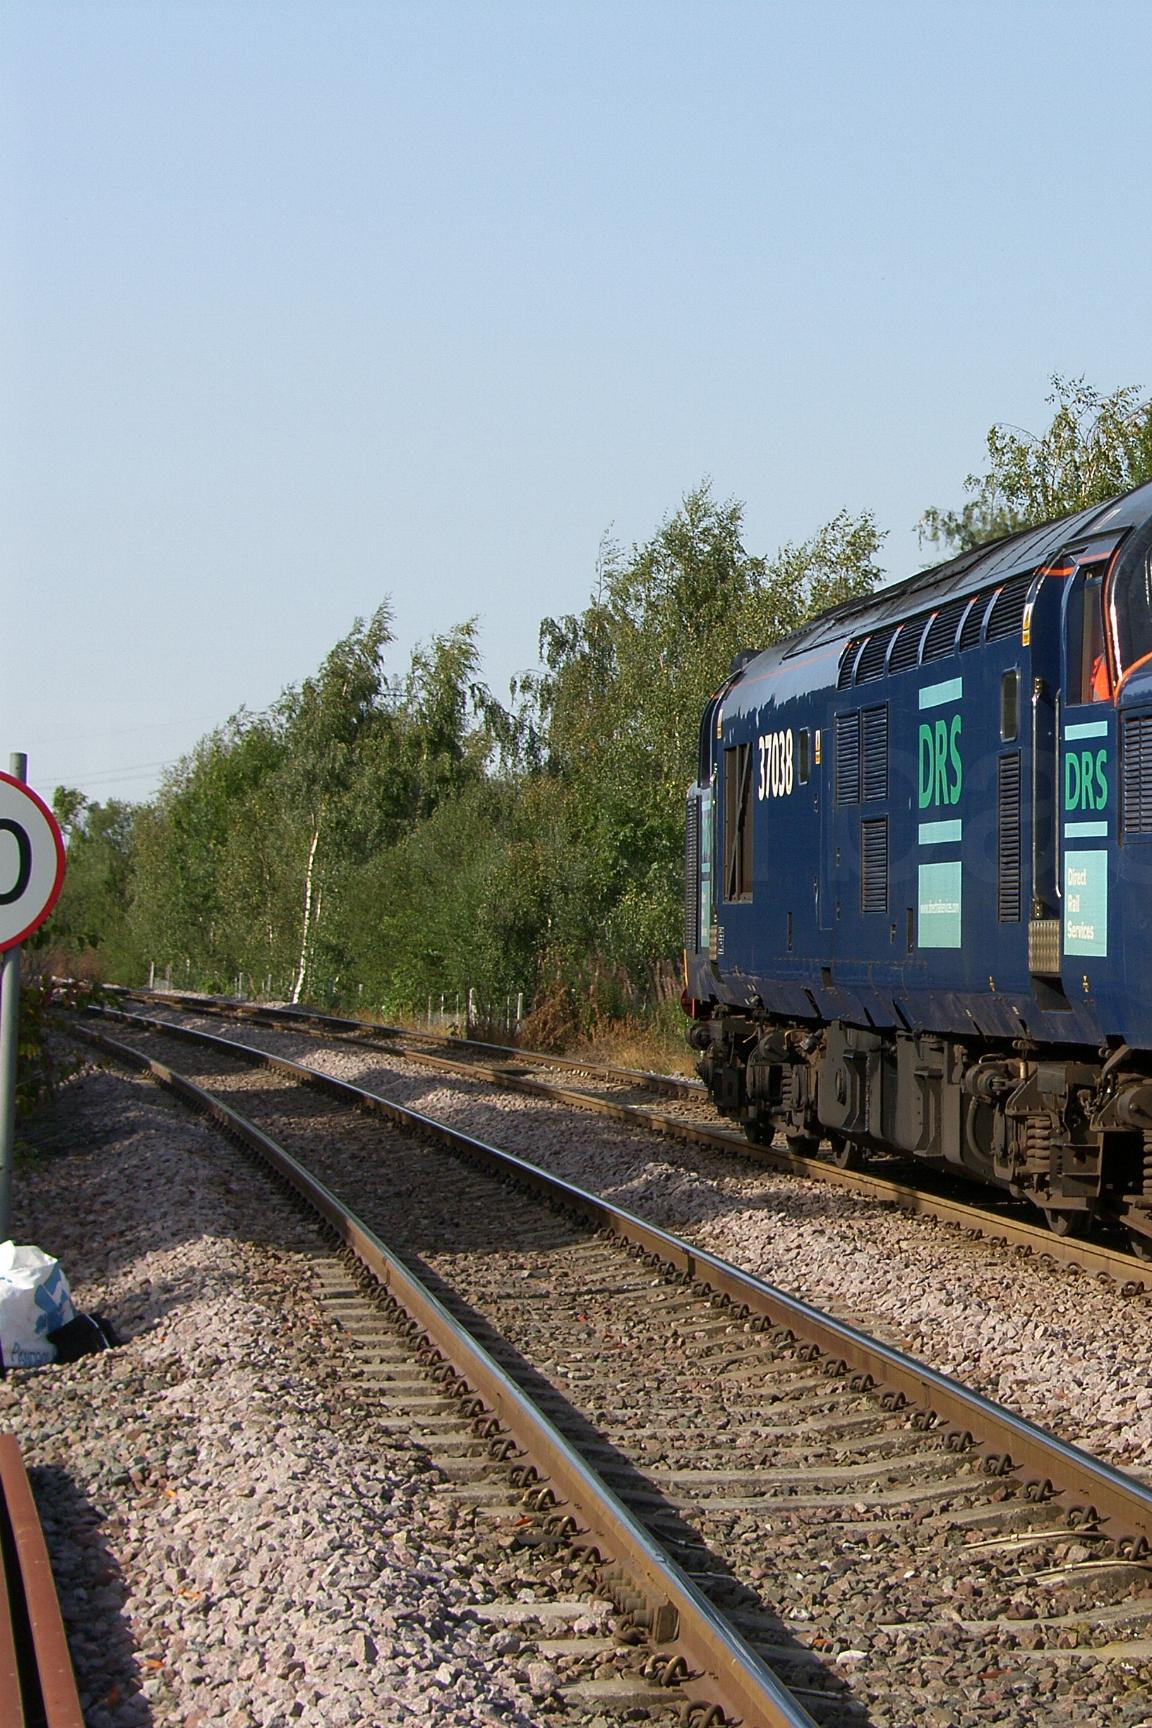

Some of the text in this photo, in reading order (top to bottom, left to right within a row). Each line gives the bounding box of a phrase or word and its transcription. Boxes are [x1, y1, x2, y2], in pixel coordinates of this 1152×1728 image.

[758, 728, 793, 801] 37038
[918, 714, 963, 809] DRS
[1064, 749, 1108, 811] DRS
[1068, 867, 1087, 886] Direct
[1068, 894, 1080, 912] Rail
[1067, 919, 1094, 940] Services
